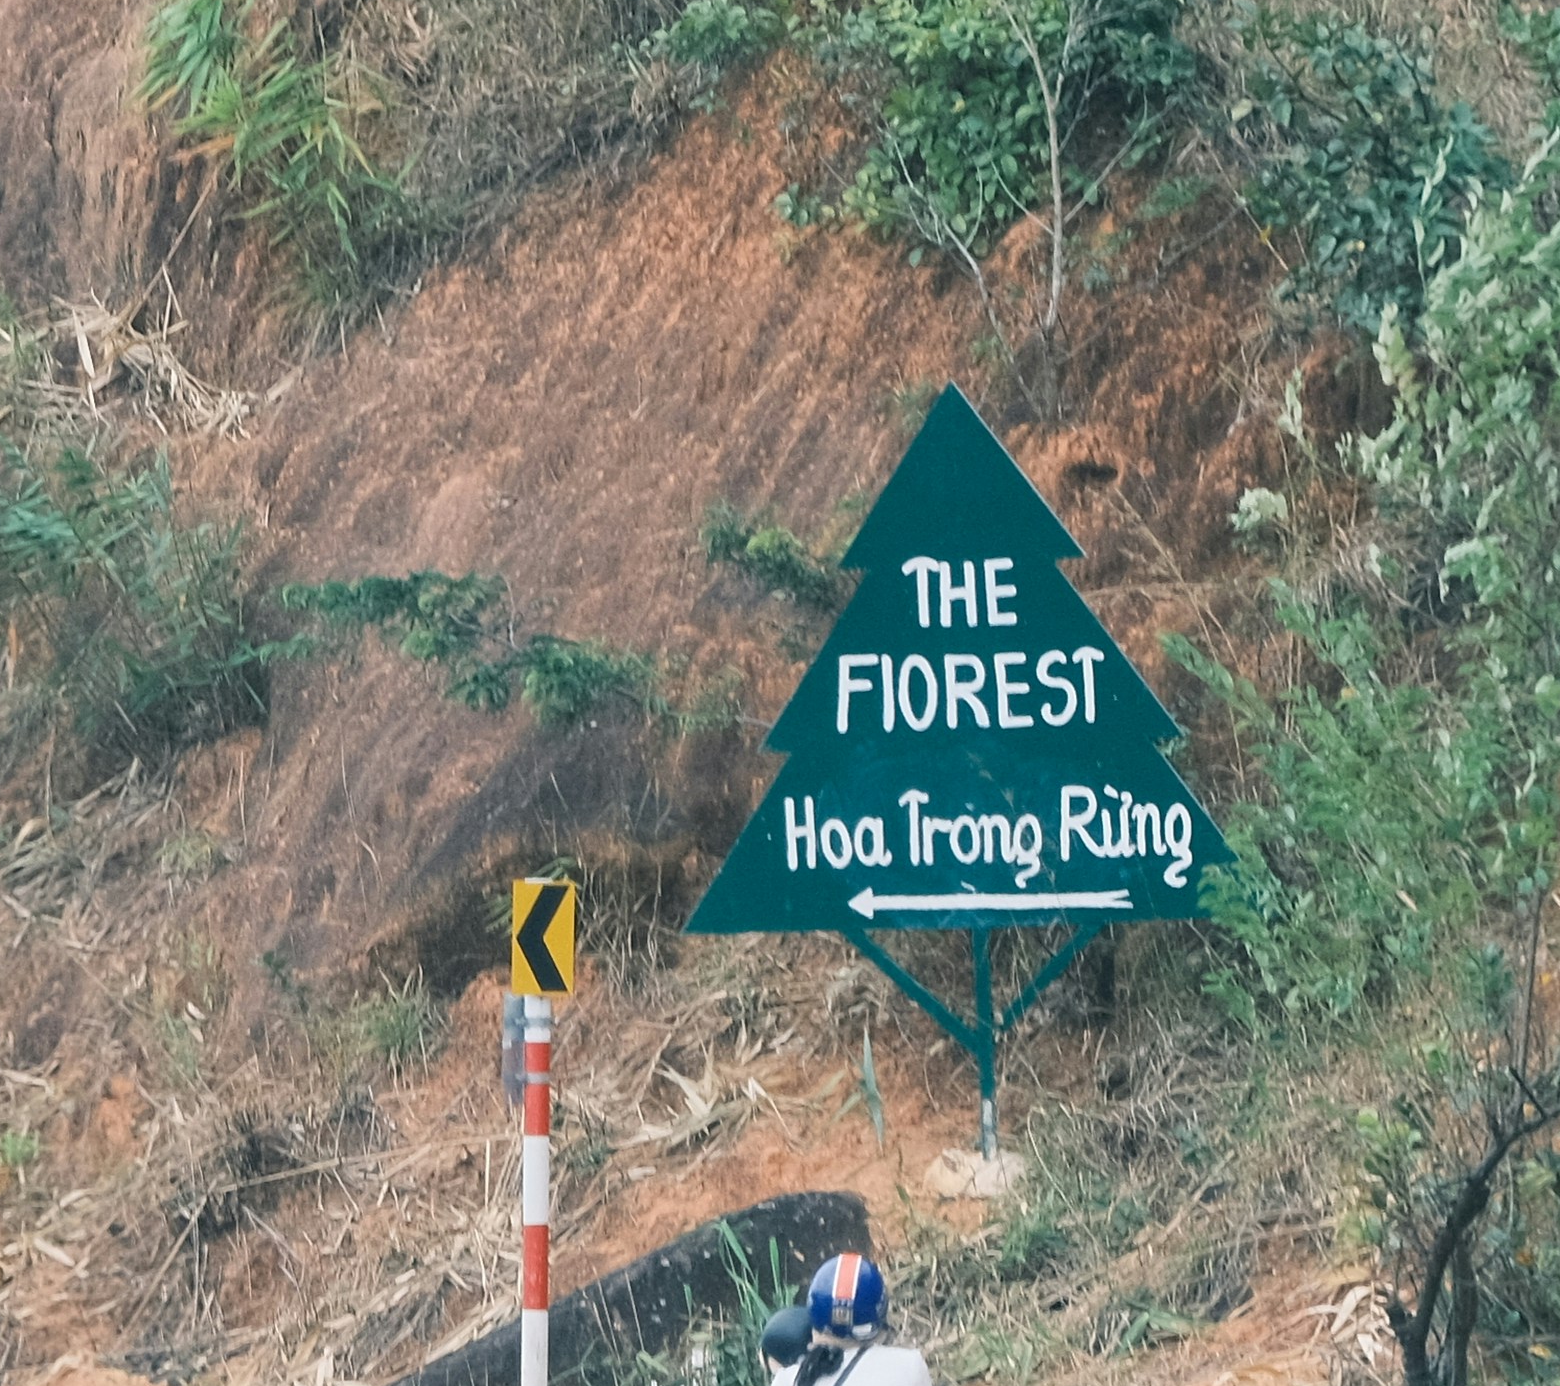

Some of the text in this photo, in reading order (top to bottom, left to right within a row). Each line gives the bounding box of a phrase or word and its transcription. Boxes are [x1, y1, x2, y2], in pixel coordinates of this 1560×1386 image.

[901, 556, 1019, 628] THE
[835, 646, 1106, 734] FIOREST
[784, 784, 1194, 889] Hoa Trong Rừng
